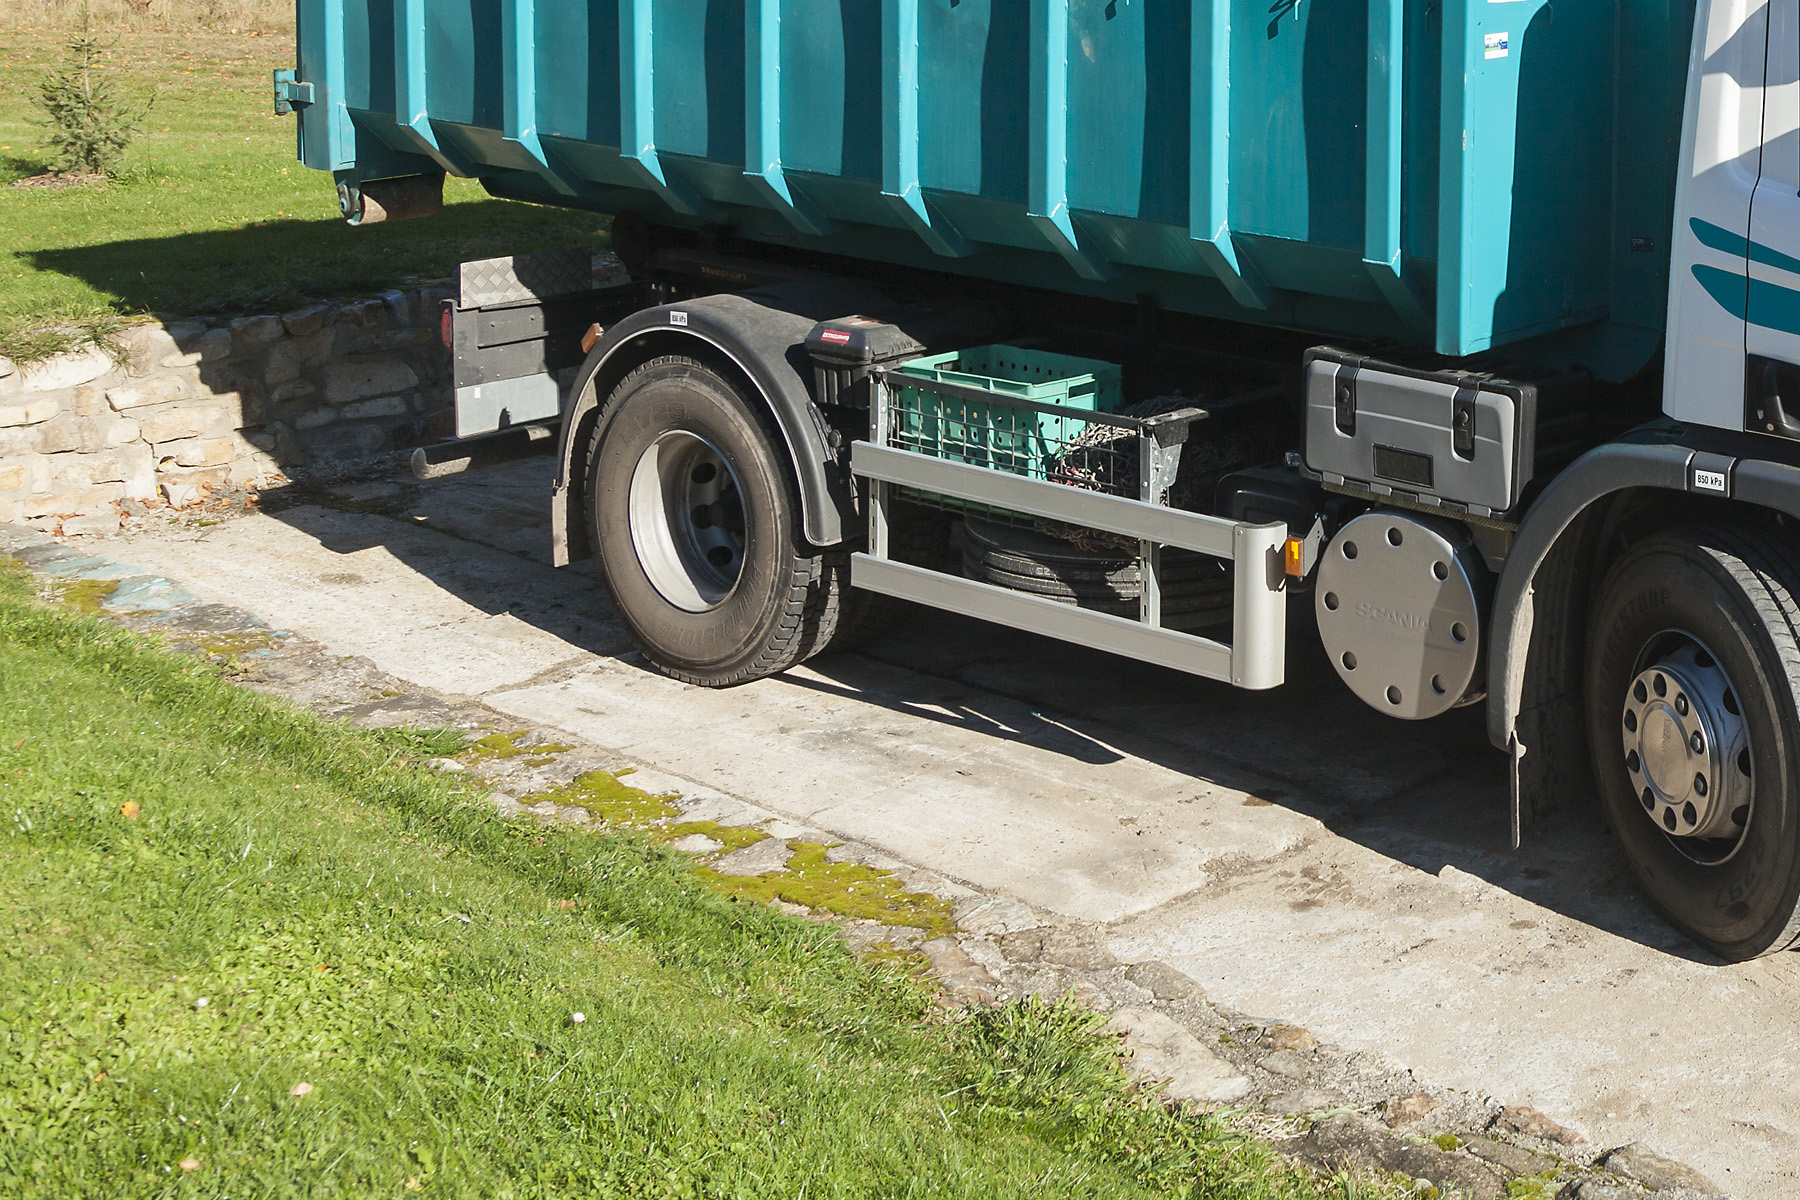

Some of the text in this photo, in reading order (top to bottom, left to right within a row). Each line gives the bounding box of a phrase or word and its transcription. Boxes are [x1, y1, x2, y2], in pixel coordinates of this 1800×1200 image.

[1697, 474, 1722, 487] 850 kPa
[1355, 602, 1434, 633] SCANIA
